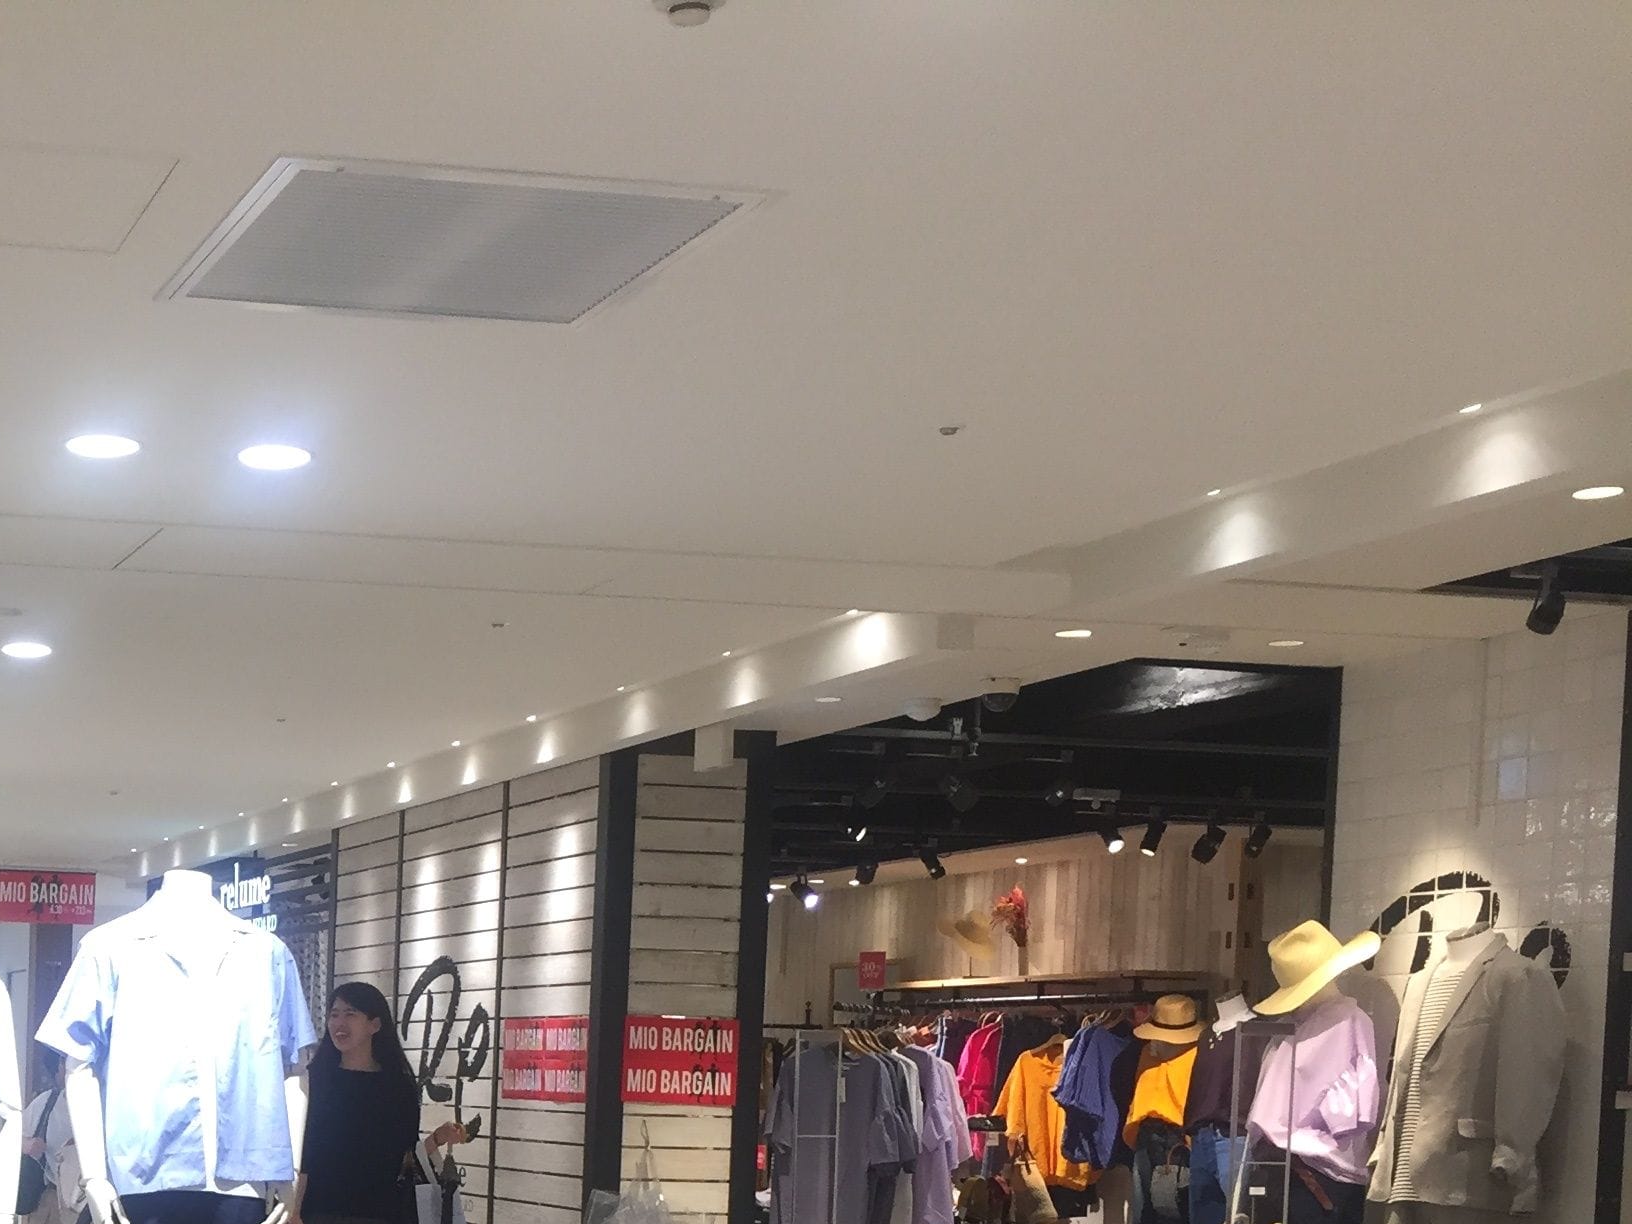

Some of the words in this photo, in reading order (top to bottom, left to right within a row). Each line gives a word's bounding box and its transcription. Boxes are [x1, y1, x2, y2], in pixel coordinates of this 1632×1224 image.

[0, 881, 27, 903] MIO
[29, 882, 94, 906] BARGAIN
[220, 861, 271, 911] relume
[629, 1026, 658, 1051] MIO
[661, 1027, 733, 1053] BARGAIN
[626, 1068, 657, 1093] MIO
[659, 1069, 732, 1096] BARGAIN
